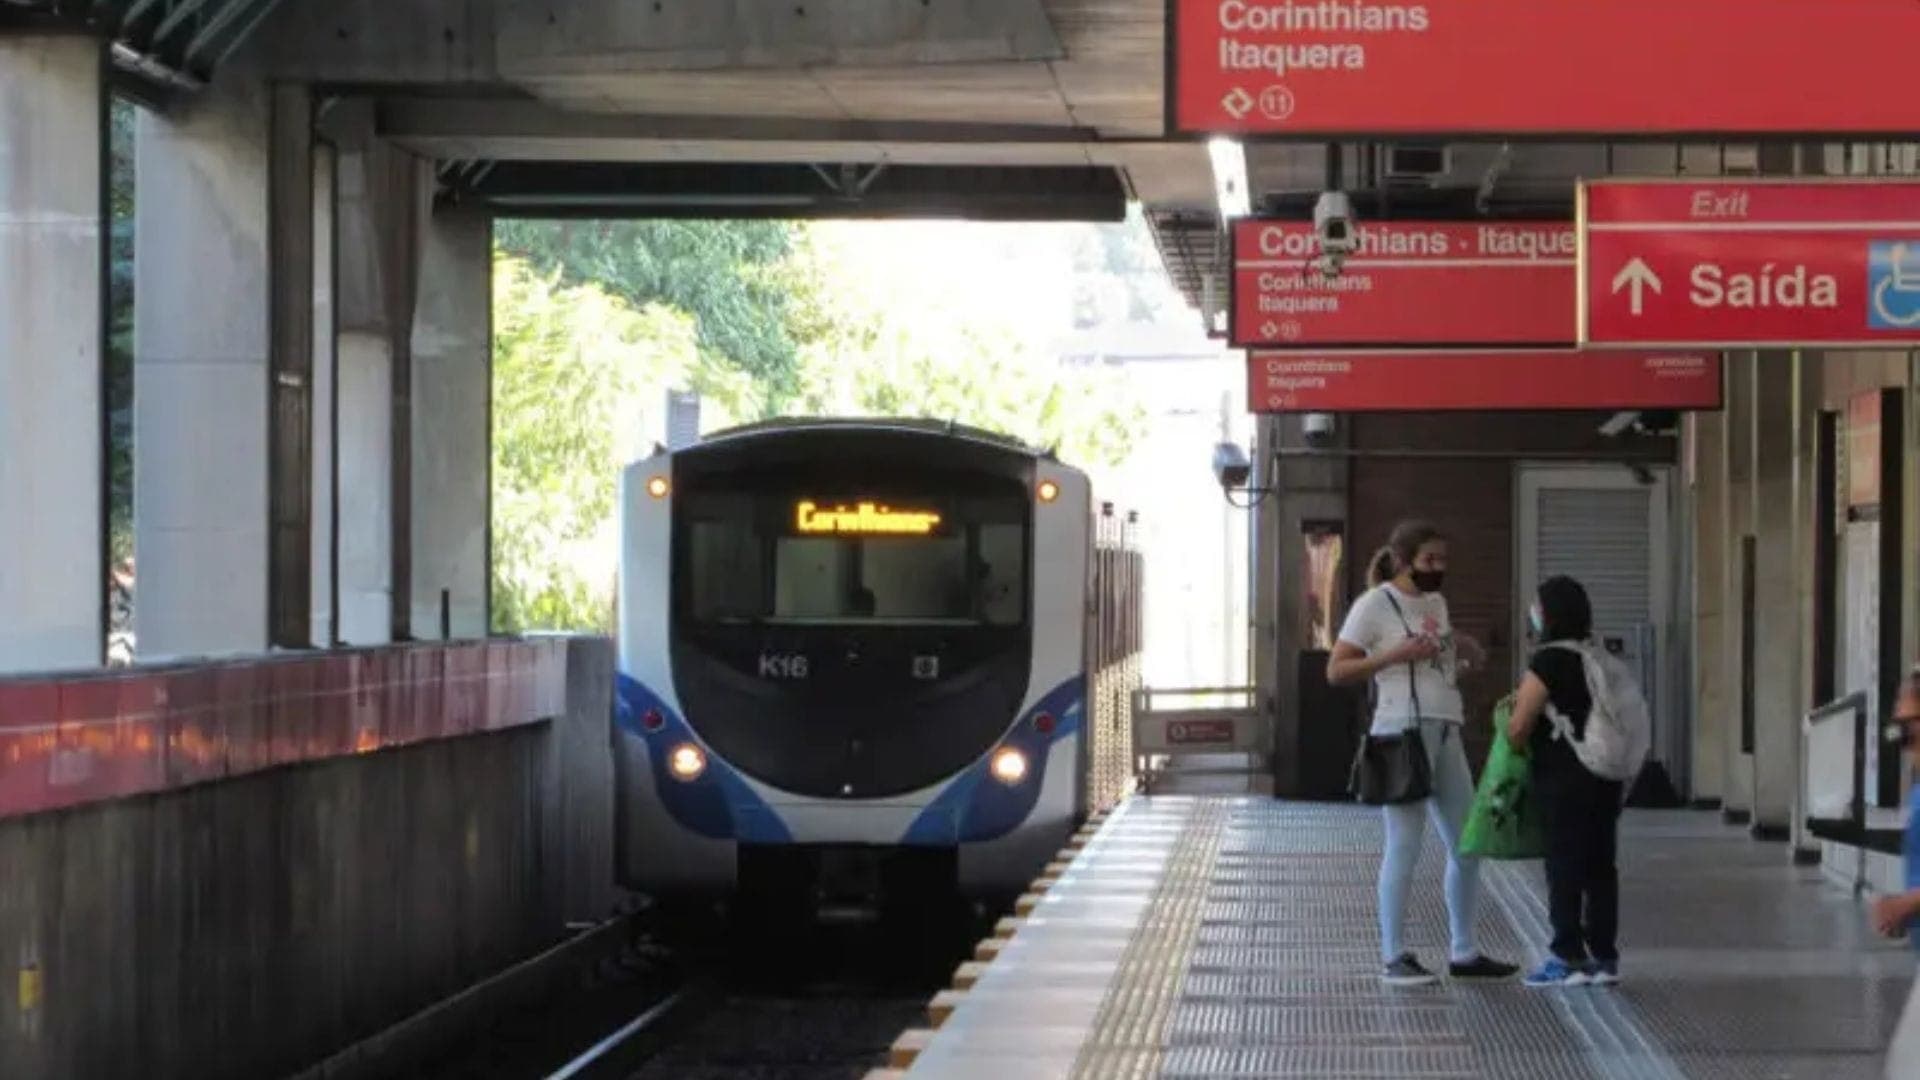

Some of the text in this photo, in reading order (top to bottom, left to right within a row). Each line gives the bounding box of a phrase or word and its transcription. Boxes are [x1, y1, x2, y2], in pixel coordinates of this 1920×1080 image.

[1218, 0, 1429, 31] Corinthians
[1218, 38, 1365, 76] Itaquera
[1690, 191, 1750, 217] Exit
[1259, 226, 1448, 256] Corhians
[1689, 263, 1838, 308] Saída
[758, 654, 809, 678] K16
